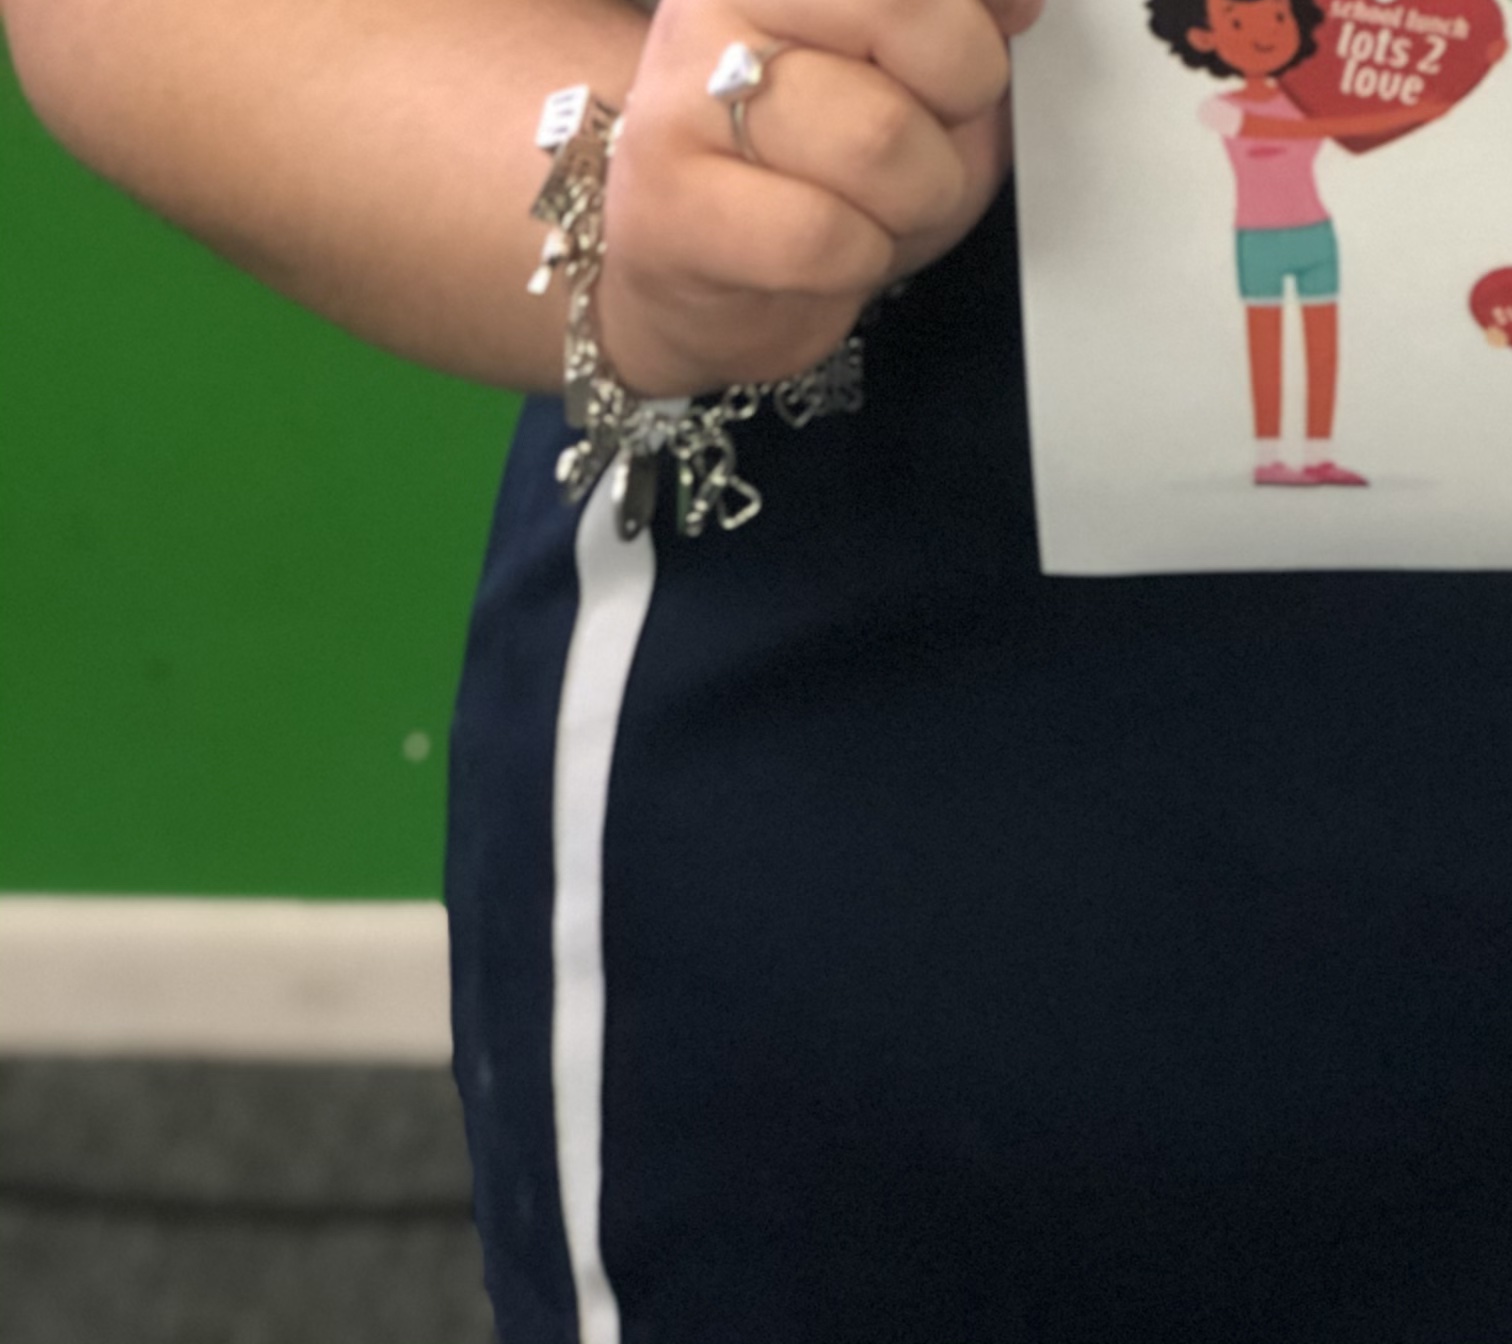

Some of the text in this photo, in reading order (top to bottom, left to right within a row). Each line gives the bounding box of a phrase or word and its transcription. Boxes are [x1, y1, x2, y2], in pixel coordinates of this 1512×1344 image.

[1336, 21, 1447, 75] lots 2
[1340, 58, 1426, 106] love
